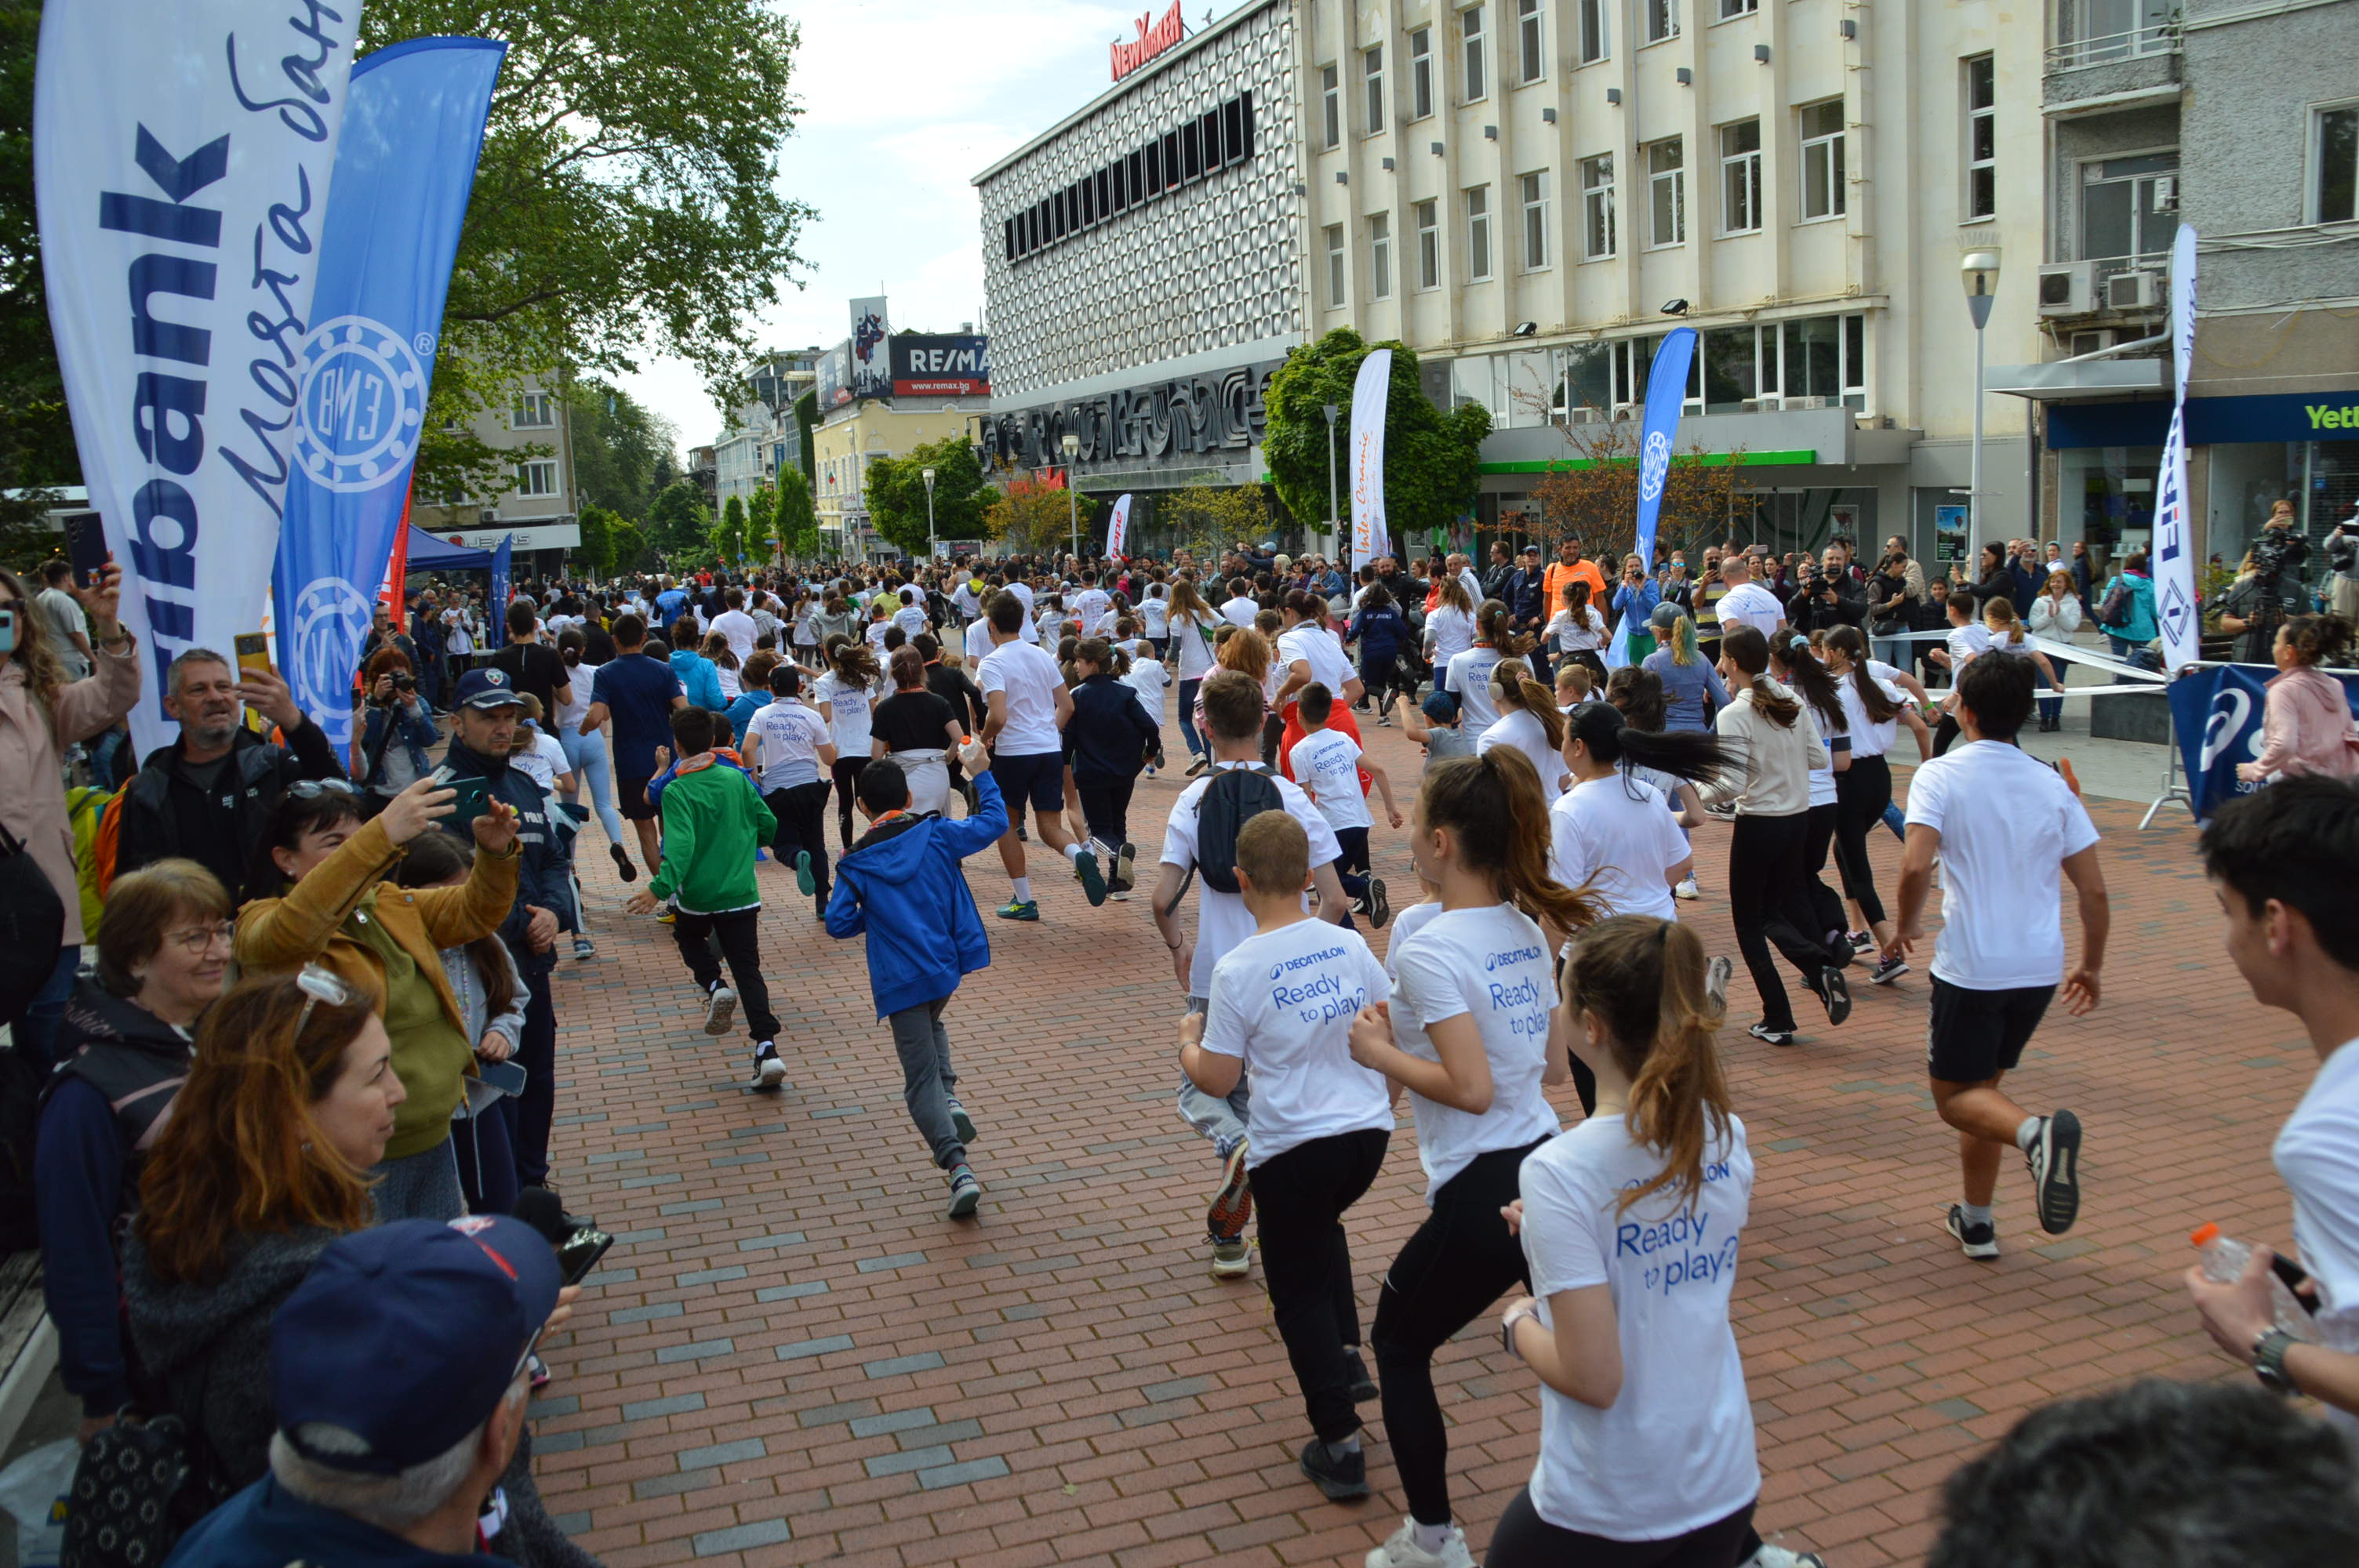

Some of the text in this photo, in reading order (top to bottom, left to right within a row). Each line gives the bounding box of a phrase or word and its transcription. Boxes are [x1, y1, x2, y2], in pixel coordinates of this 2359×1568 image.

[911, 381, 970, 390] www.remax.bg
[833, 697, 858, 707] Ready
[846, 703, 867, 716] play?
[766, 721, 797, 732] Ready
[783, 733, 807, 742] play?
[1285, 946, 1347, 971] DECATHLON
[1272, 973, 1341, 1010] Ready
[1488, 975, 1540, 1011] Ready
[1299, 987, 1366, 1025] to play?
[1510, 1018, 1524, 1034] to
[1616, 1206, 1709, 1258] Ready
[1664, 1235, 1739, 1297] play?
